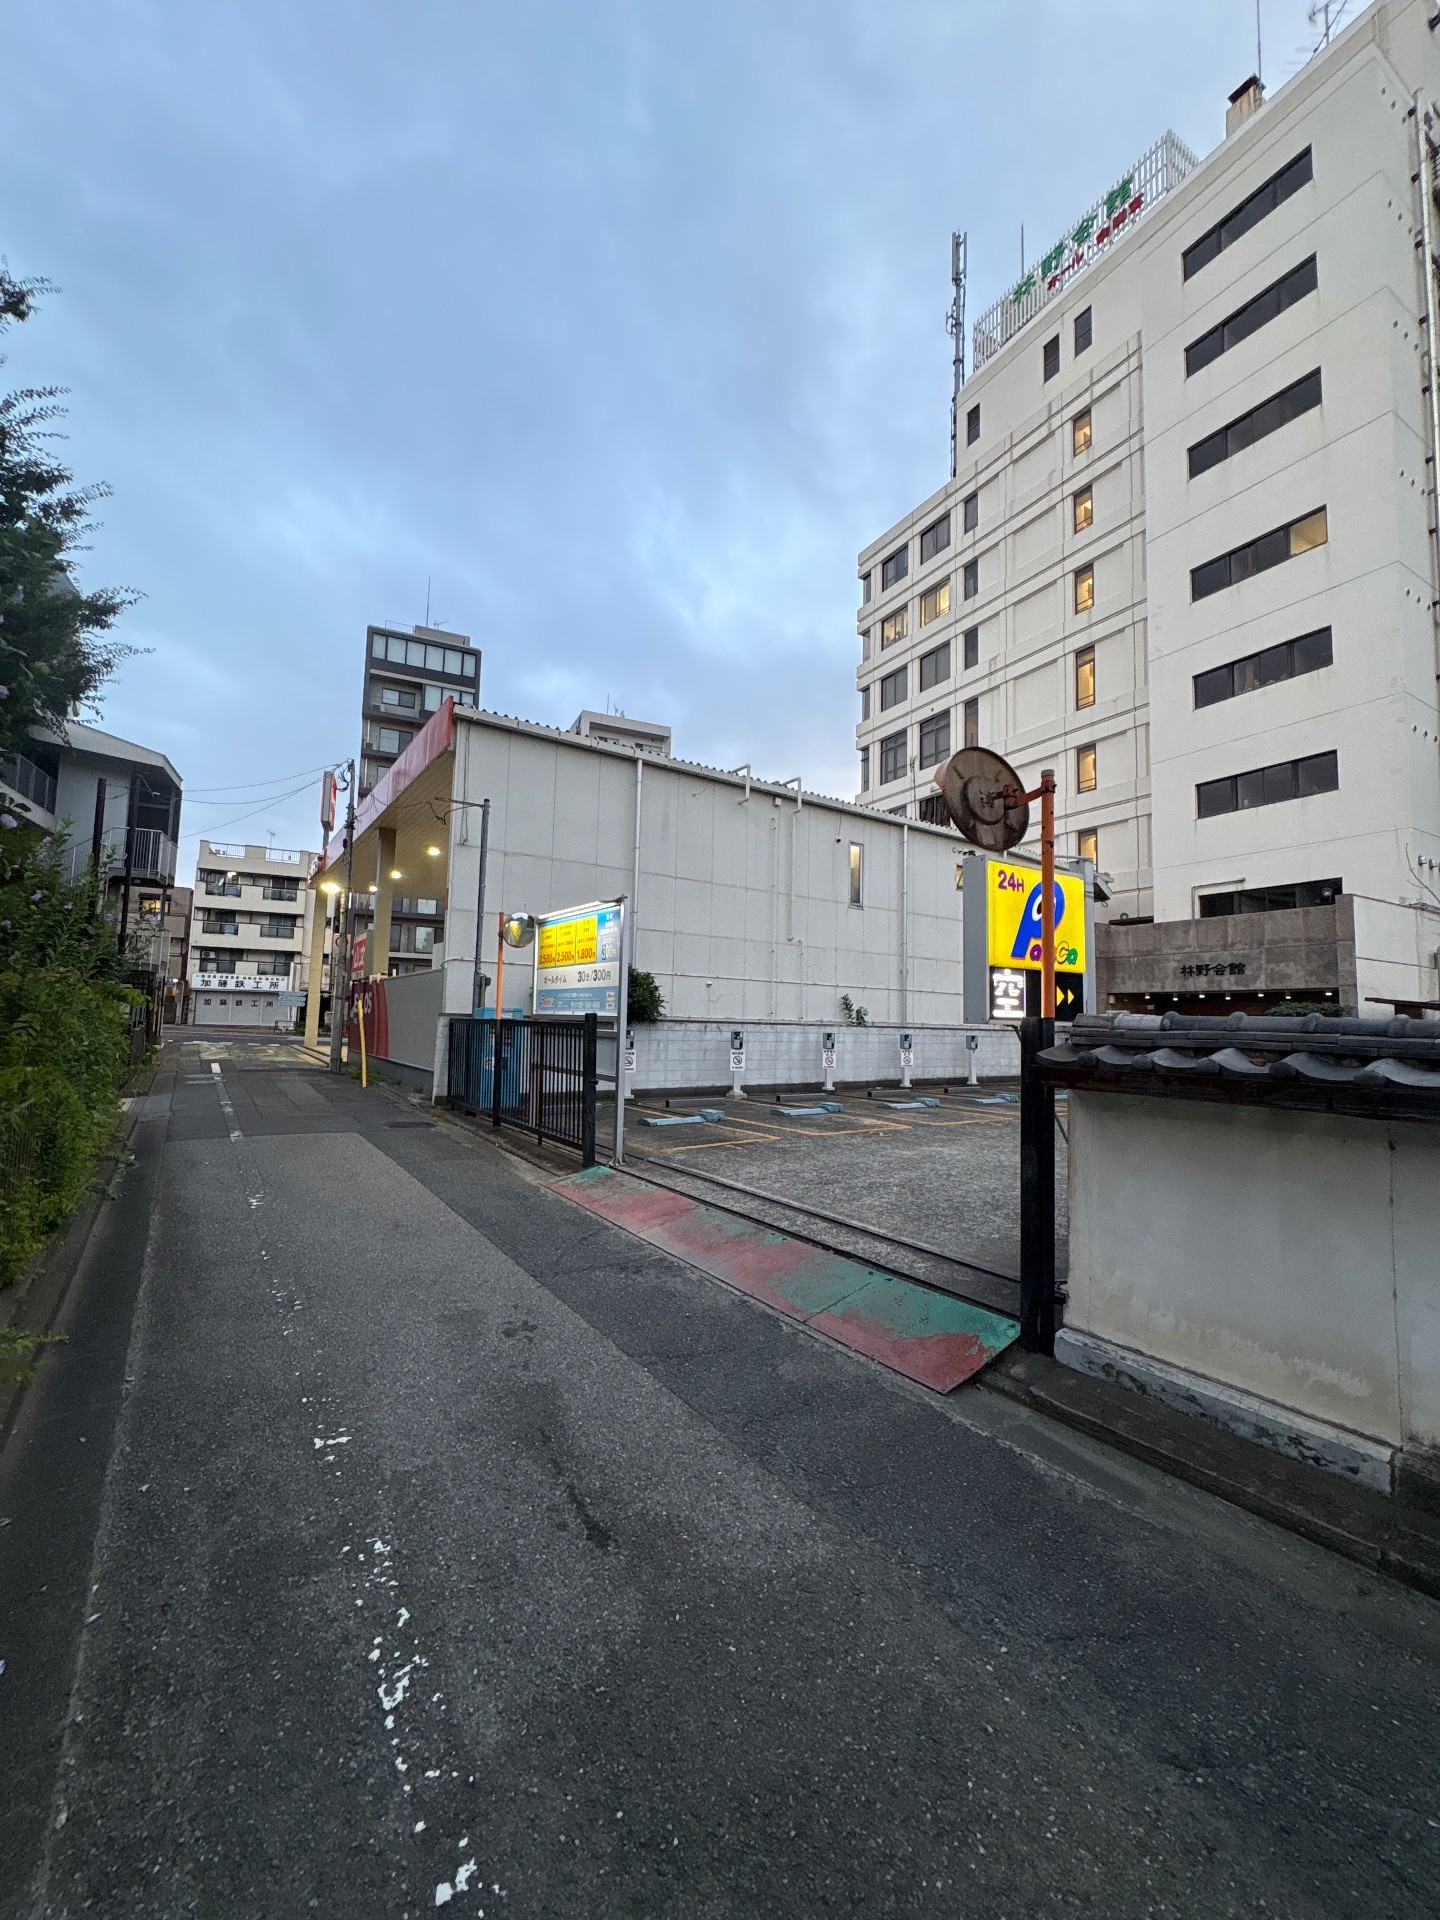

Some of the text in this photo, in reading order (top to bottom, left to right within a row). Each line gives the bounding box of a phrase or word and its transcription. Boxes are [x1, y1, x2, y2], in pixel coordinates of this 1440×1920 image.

[998, 869, 1025, 893] 24H
[1180, 962, 1247, 977] 林野会館
[200, 978, 280, 990] 加藤鉄工所
[203, 998, 274, 1008] 加藤鉄工所
